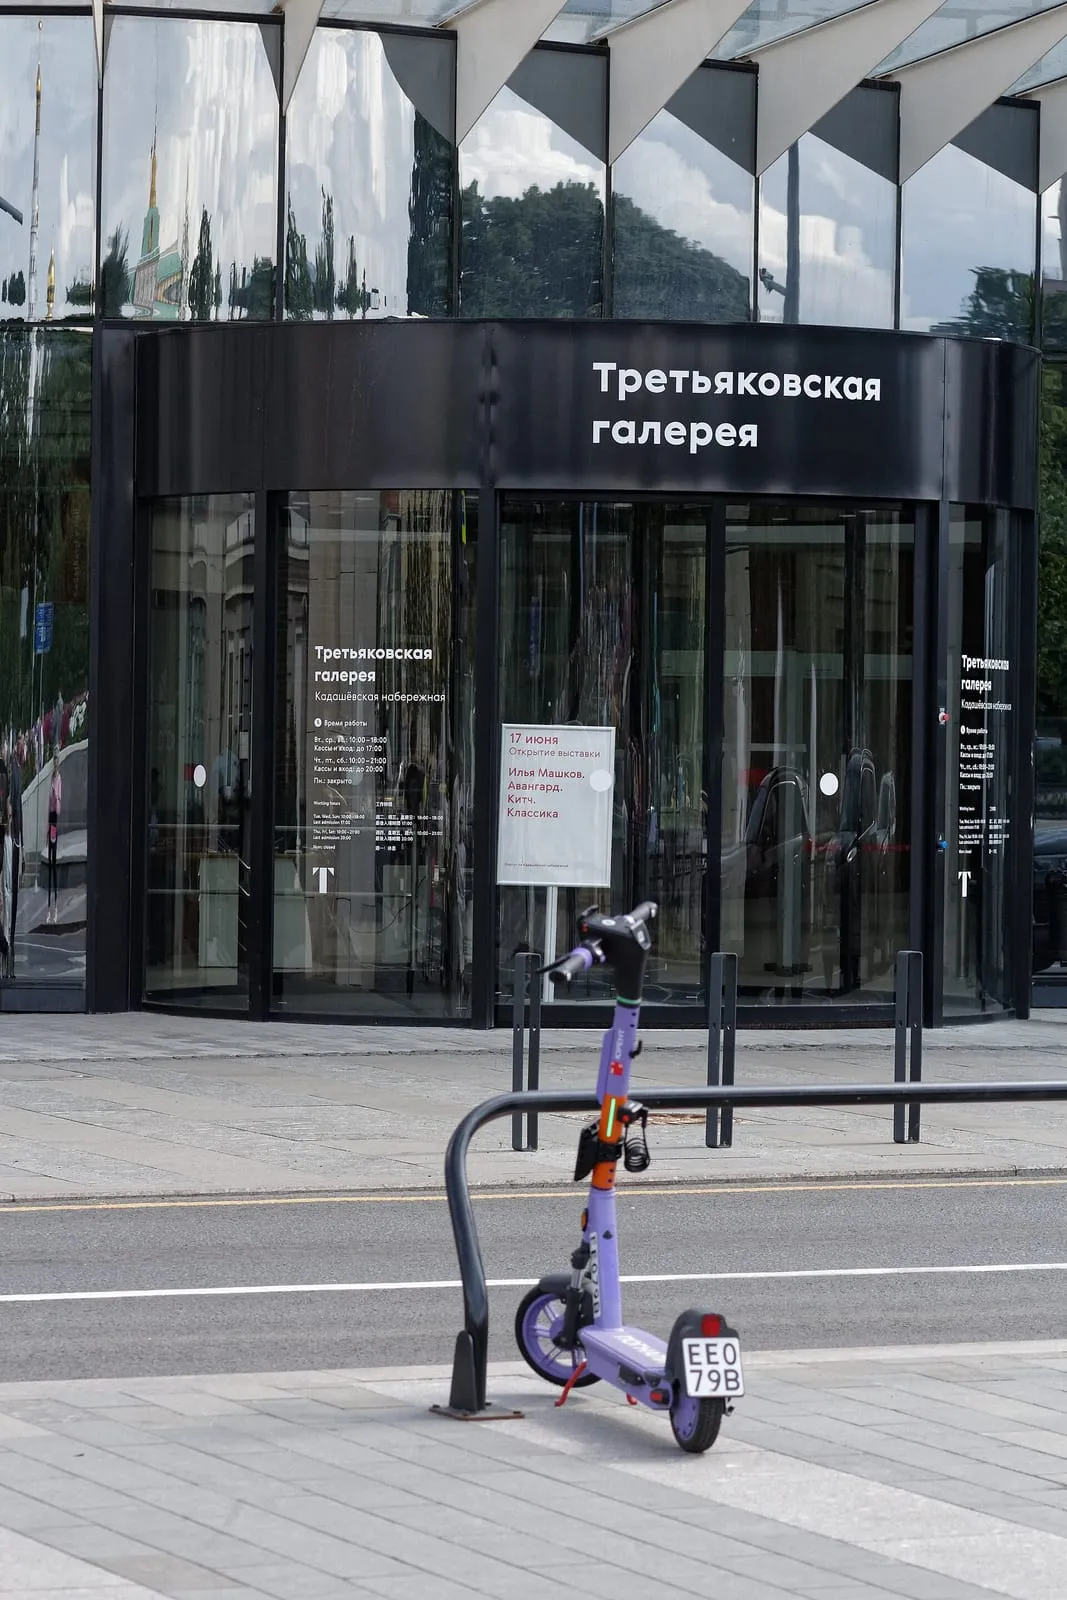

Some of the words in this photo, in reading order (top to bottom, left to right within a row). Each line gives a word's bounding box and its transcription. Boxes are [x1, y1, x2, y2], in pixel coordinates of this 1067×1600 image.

[592, 362, 881, 401] Третьяковская
[592, 420, 759, 454] галерея
[314, 645, 433, 663] Третьяковская
[314, 671, 376, 685] галерея
[961, 679, 992, 694] галерея
[315, 691, 379, 702] Кадашёвская
[381, 691, 446, 703] набережная
[324, 719, 343, 728] Время
[344, 719, 368, 728] работы
[509, 733, 522, 744] 17
[525, 736, 559, 745] июня
[508, 747, 556, 758] Открытие
[558, 750, 601, 758] выставки
[365, 765, 384, 773] 20:00
[508, 767, 535, 777] Илья
[538, 768, 585, 779] Машков.
[327, 778, 353, 786] закрыто
[507, 781, 563, 794] Авангард.
[507, 794, 536, 804] Китч.
[507, 808, 559, 818] Классика
[689, 1369, 740, 1393] 79B
